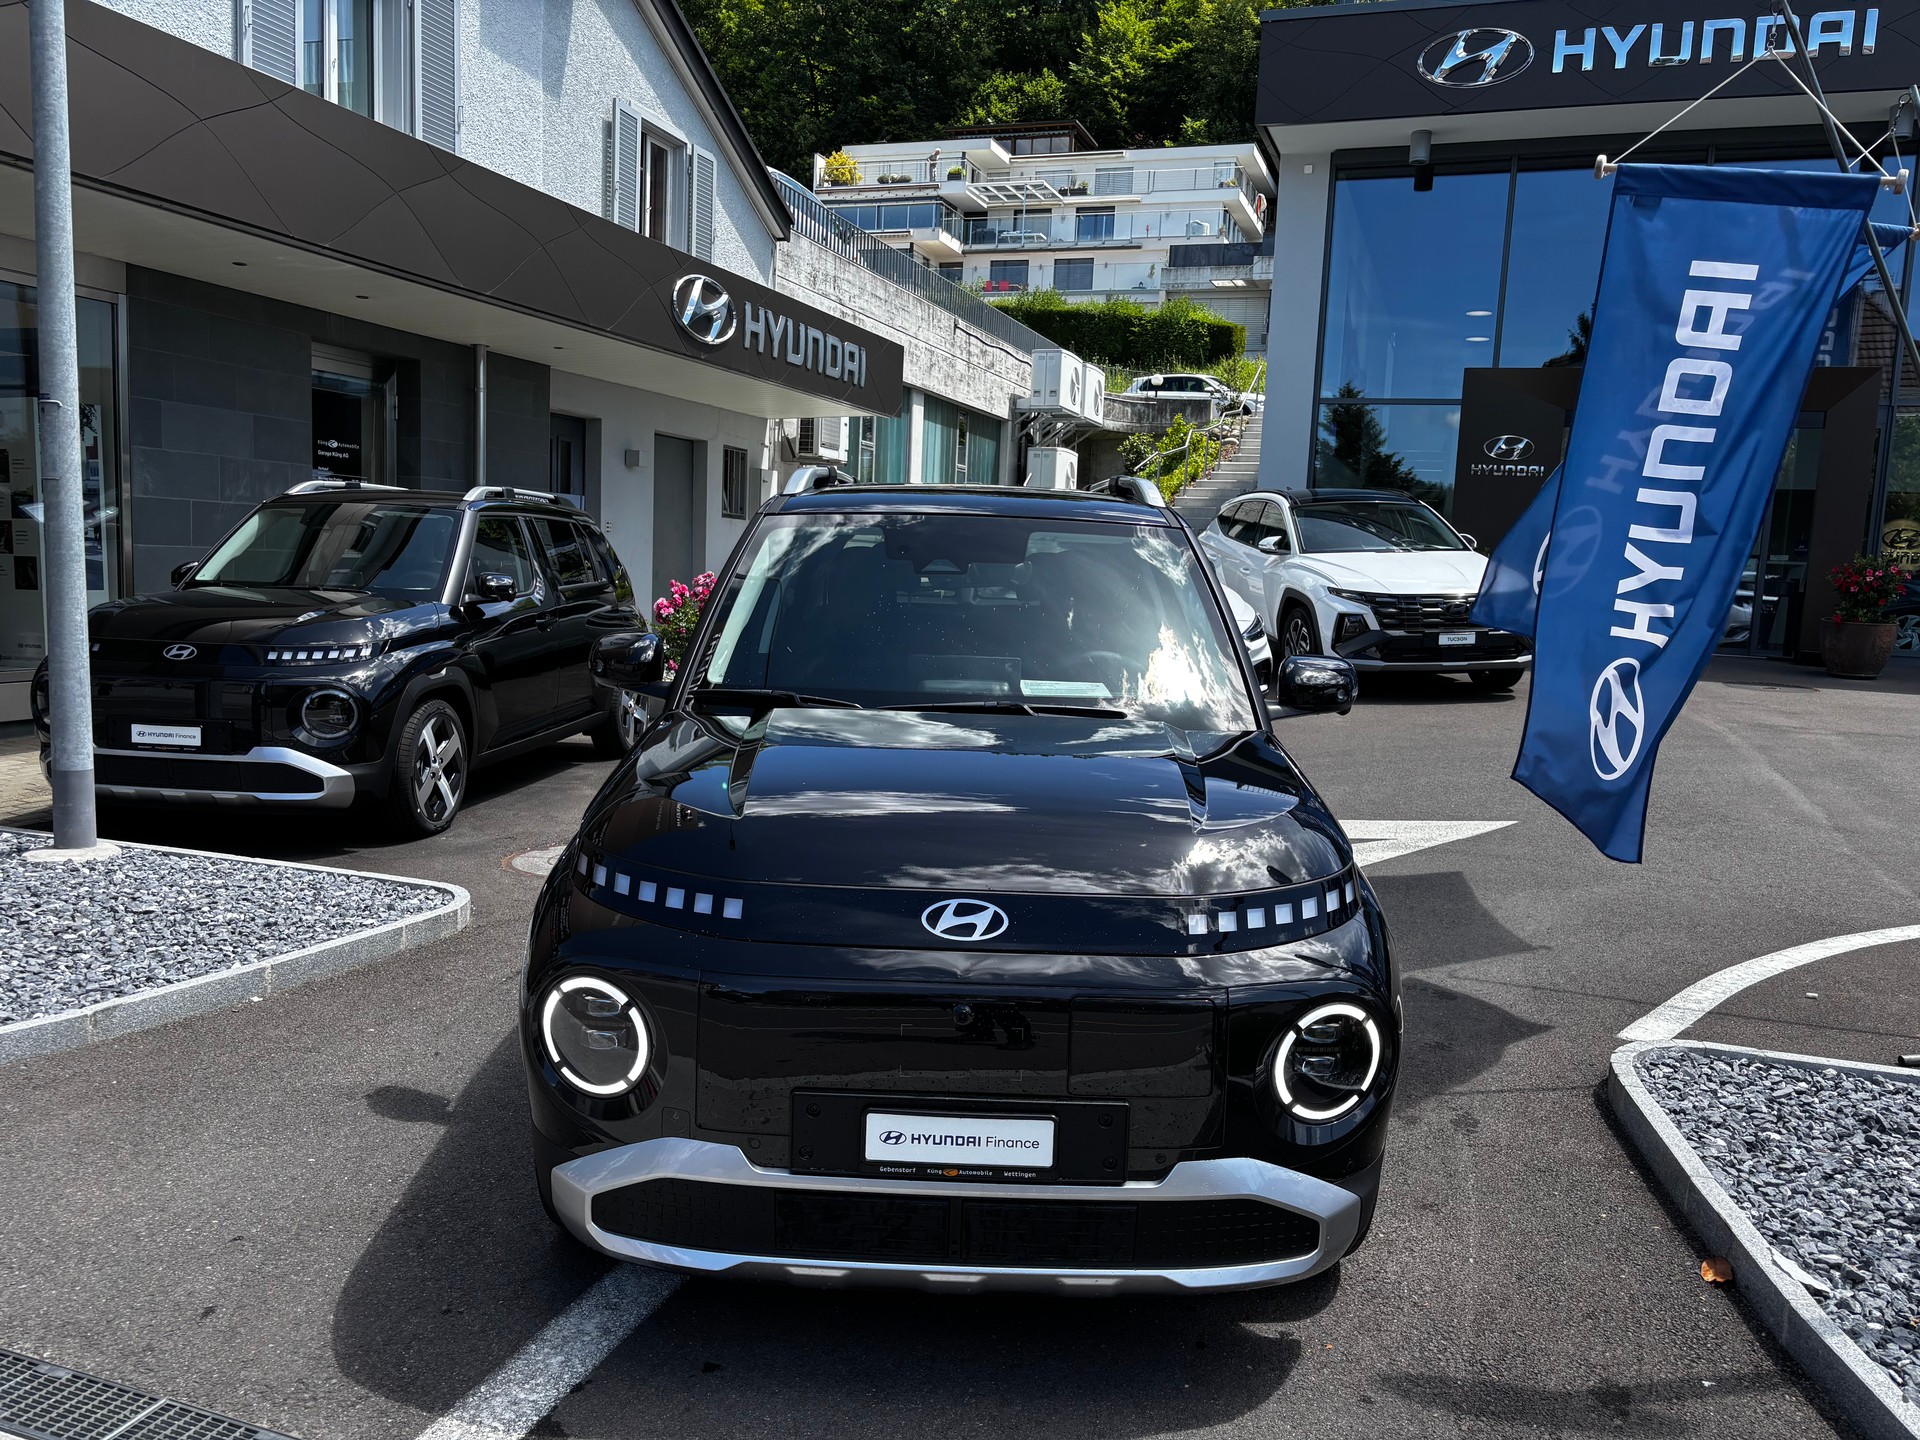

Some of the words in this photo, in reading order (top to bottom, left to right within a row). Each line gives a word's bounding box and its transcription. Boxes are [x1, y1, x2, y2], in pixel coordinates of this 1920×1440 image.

[1552, 8, 1879, 73] HYUNDAI
[743, 301, 867, 388] HYUNDAI
[1470, 464, 1545, 477] HYUNDAI
[1610, 260, 1759, 649] HYUNDAI
[911, 1133, 982, 1148] HYUNDAI
[986, 1136, 1040, 1149] Finance
[879, 1166, 917, 1174] Gebenstorf
